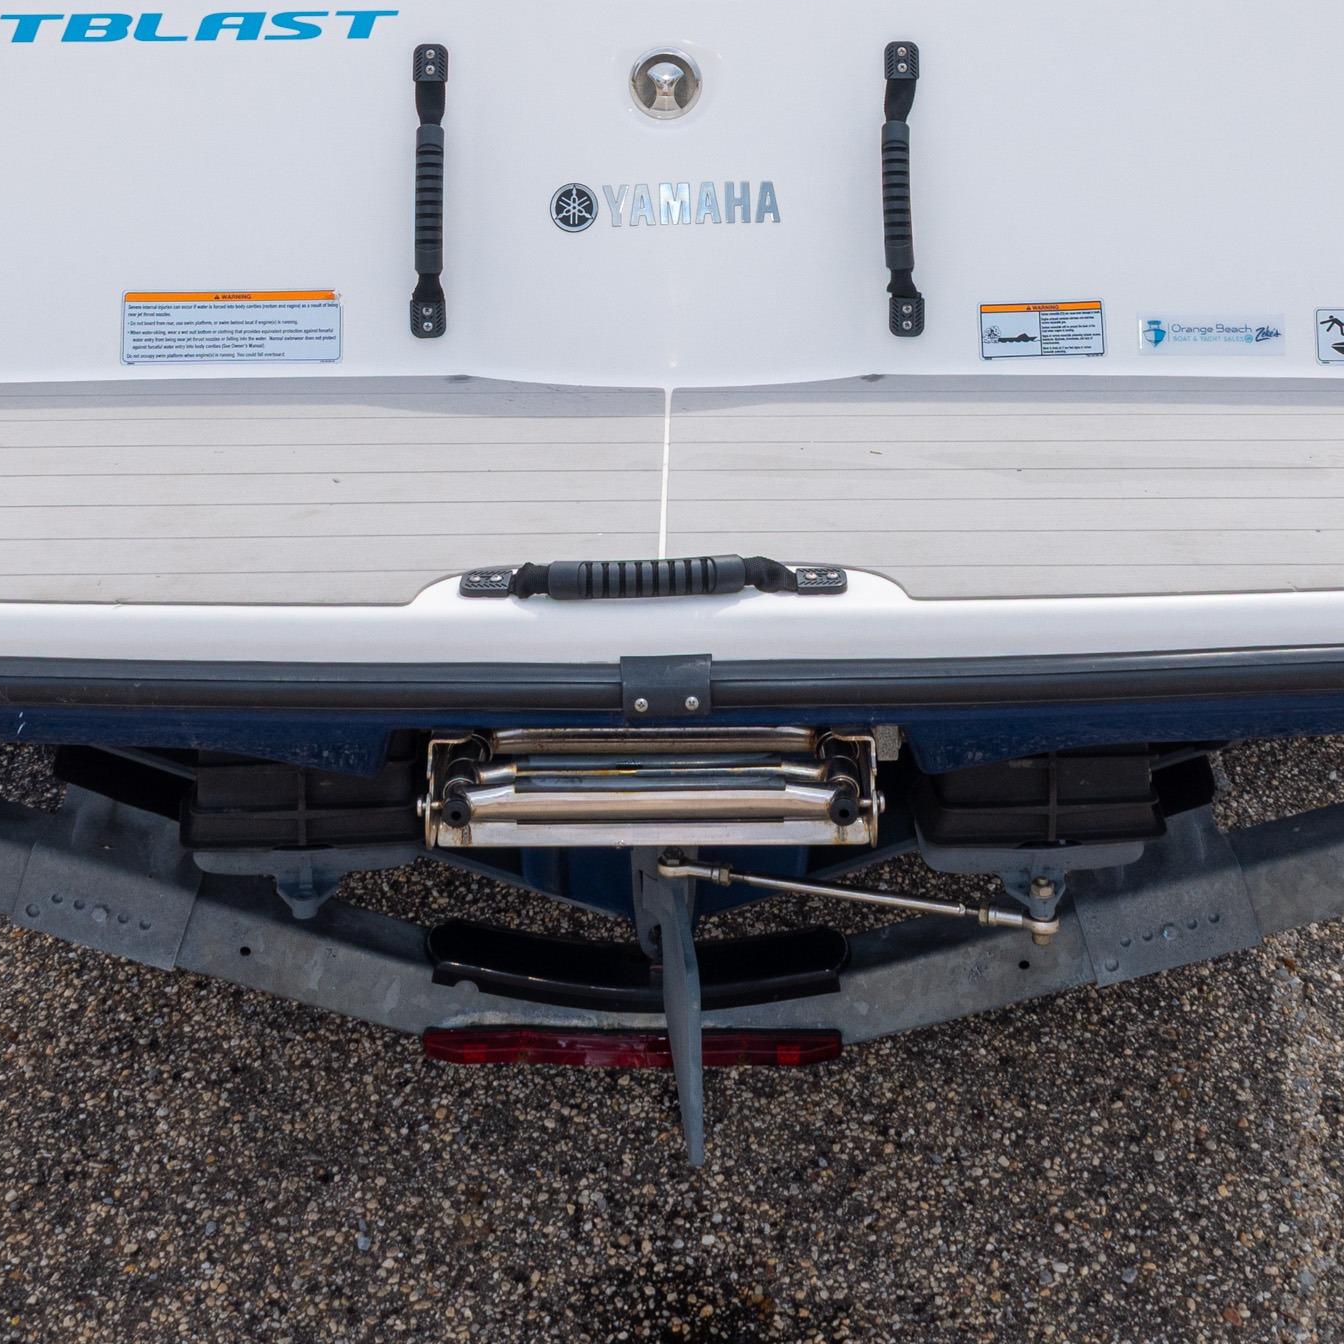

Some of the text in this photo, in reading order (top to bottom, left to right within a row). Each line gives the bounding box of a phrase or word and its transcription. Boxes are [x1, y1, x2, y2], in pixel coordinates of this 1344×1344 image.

[602, 181, 781, 227] YAMAHA
[1172, 324, 1252, 335] Orange Beach
